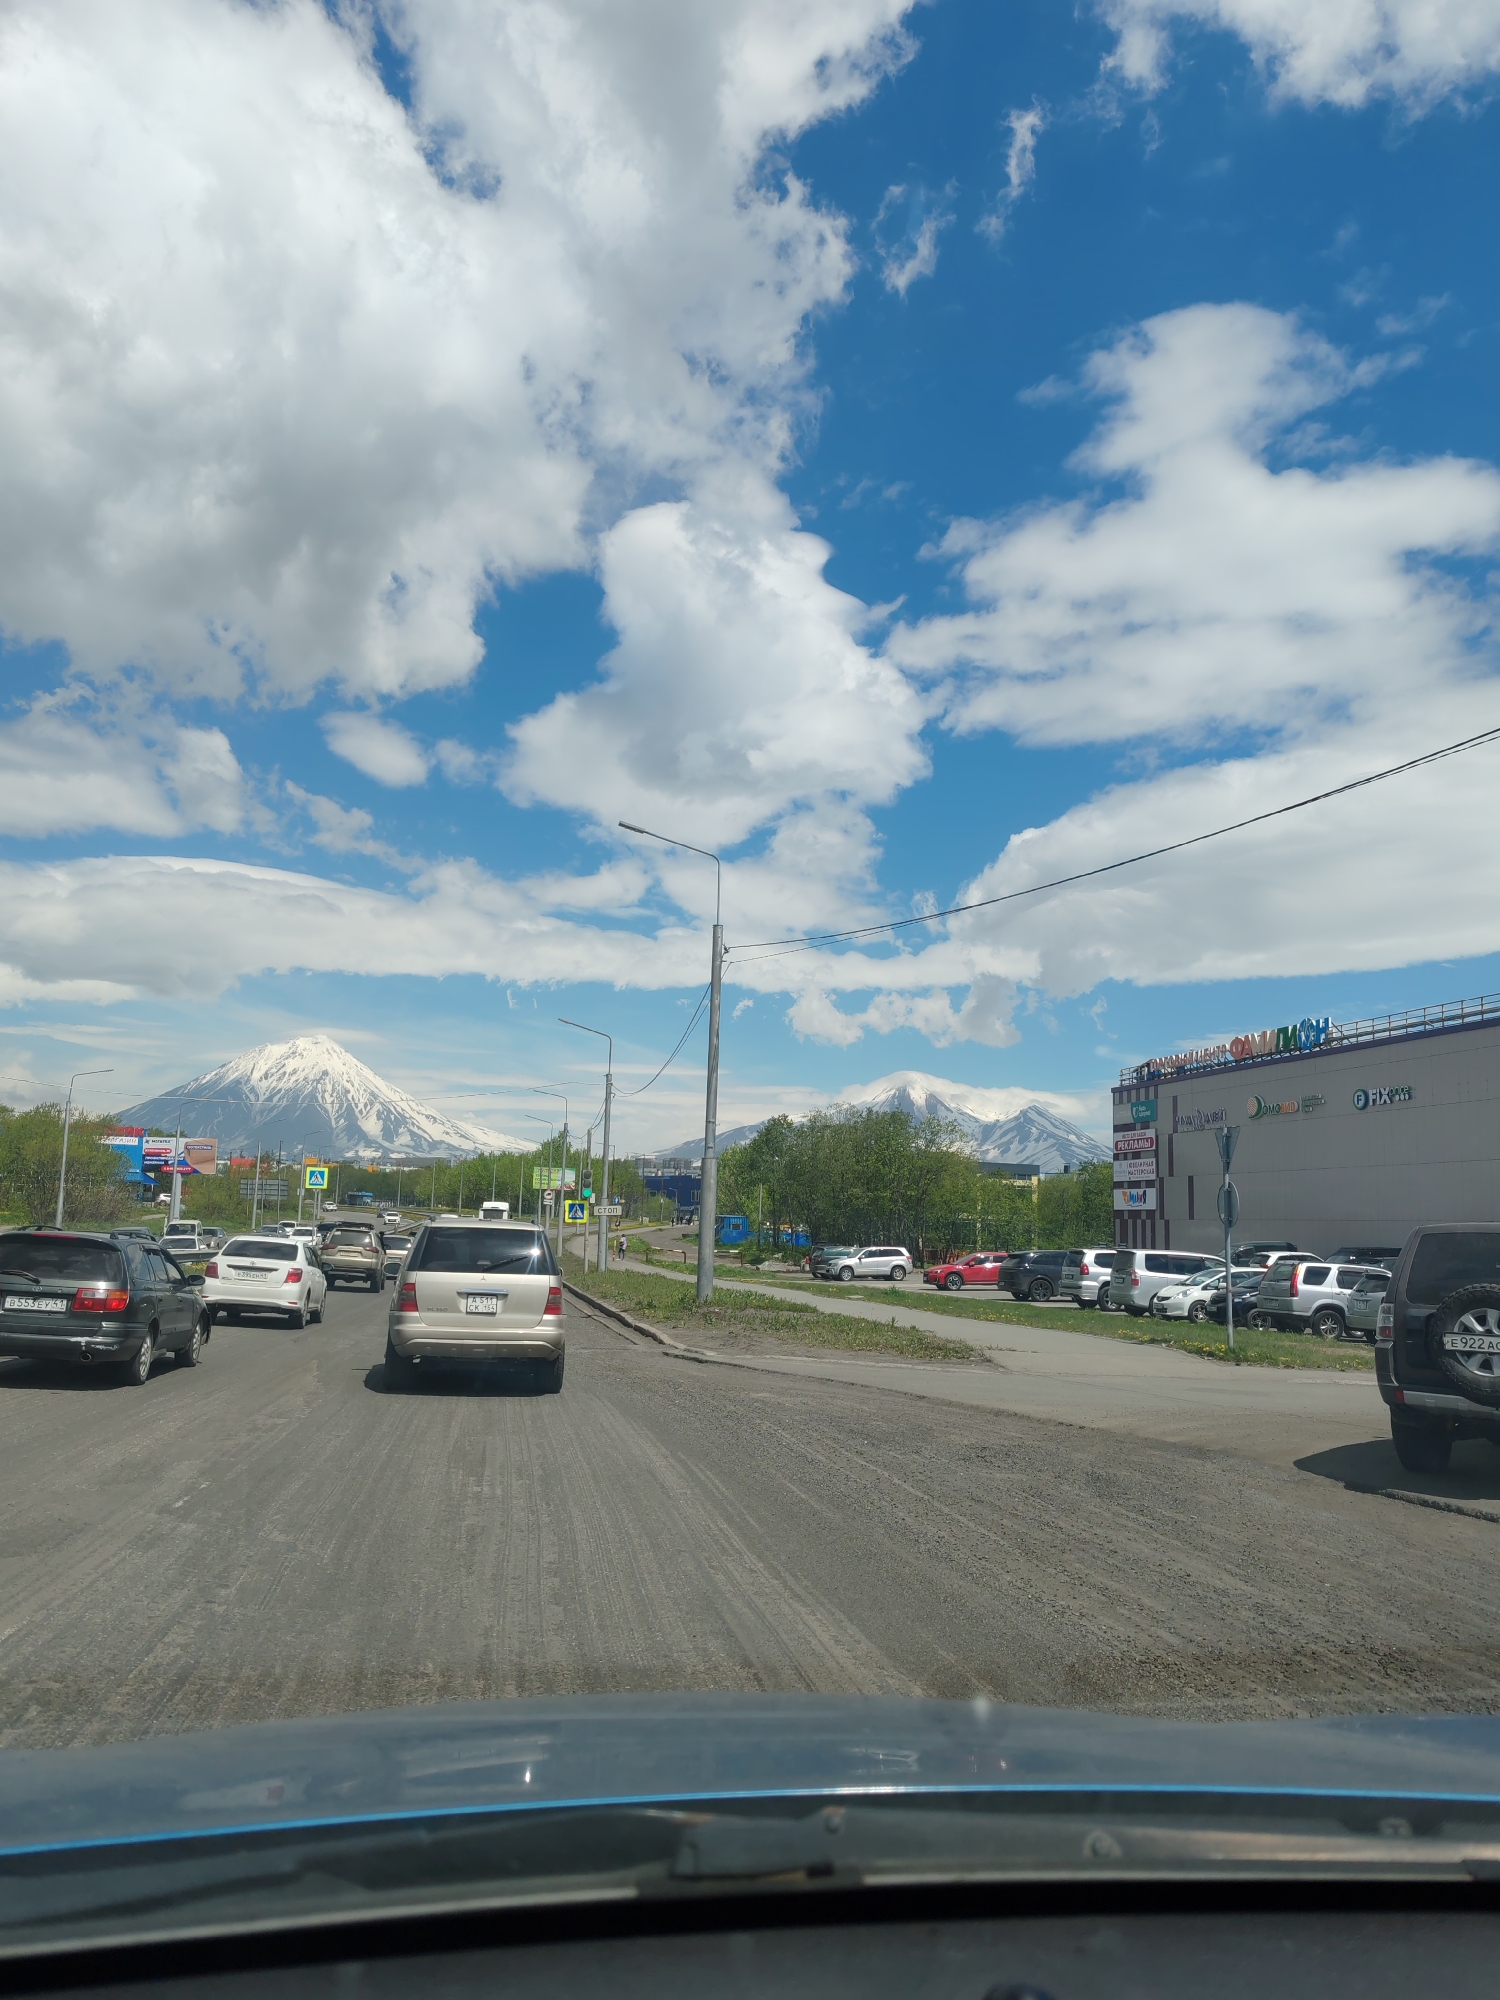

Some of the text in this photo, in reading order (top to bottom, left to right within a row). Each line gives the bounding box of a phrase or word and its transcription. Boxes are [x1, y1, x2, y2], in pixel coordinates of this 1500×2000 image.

[1150, 1048, 1194, 1071] ТОРГОВЫЙ
[1197, 1043, 1229, 1063] ЦЕНТР
[1117, 1138, 1151, 1151] РЕКЛАМЫ
[1127, 1168, 1155, 1176] МАСТЕРСКАЯ
